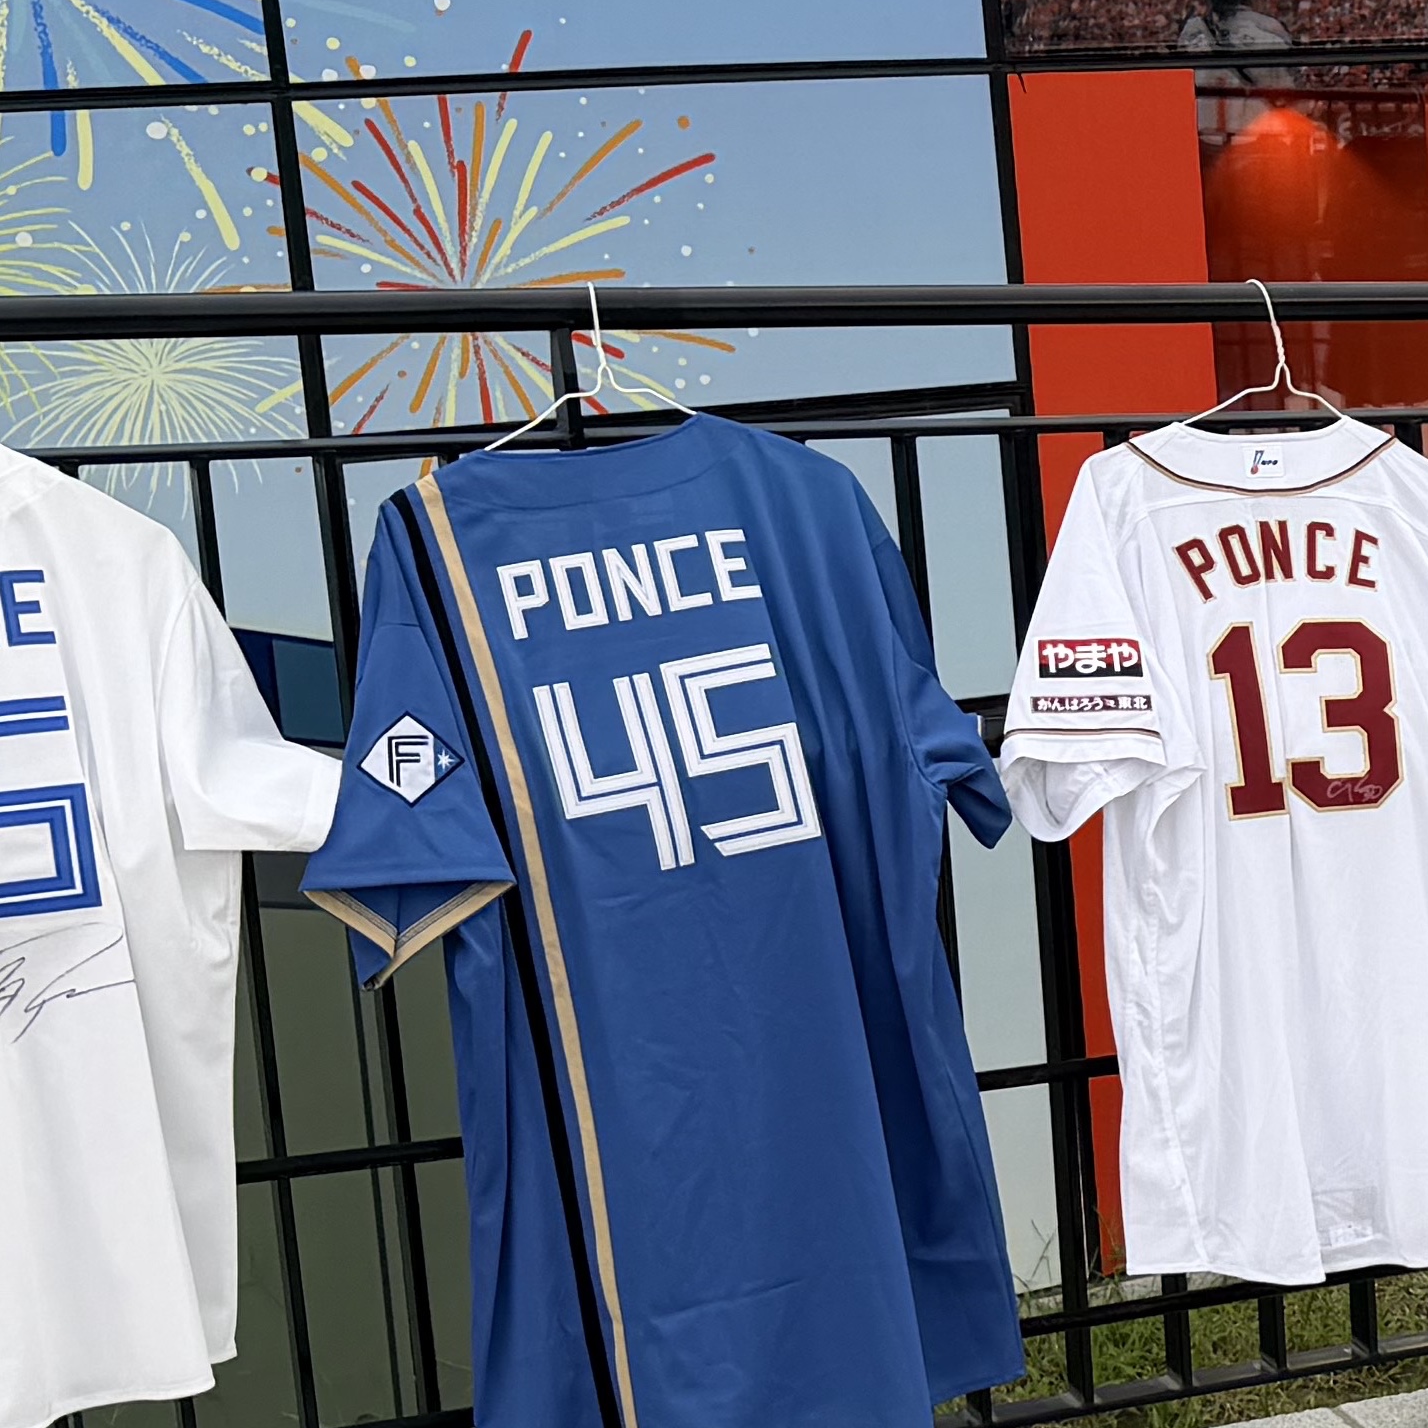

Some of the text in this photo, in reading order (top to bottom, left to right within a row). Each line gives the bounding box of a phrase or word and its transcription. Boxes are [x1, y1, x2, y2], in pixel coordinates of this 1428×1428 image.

[497, 528, 764, 640] PONCE
[1173, 518, 1381, 605] PONCE
[1042, 641, 1139, 675] やまや
[533, 643, 825, 871] 45
[1206, 618, 1405, 821] 13
